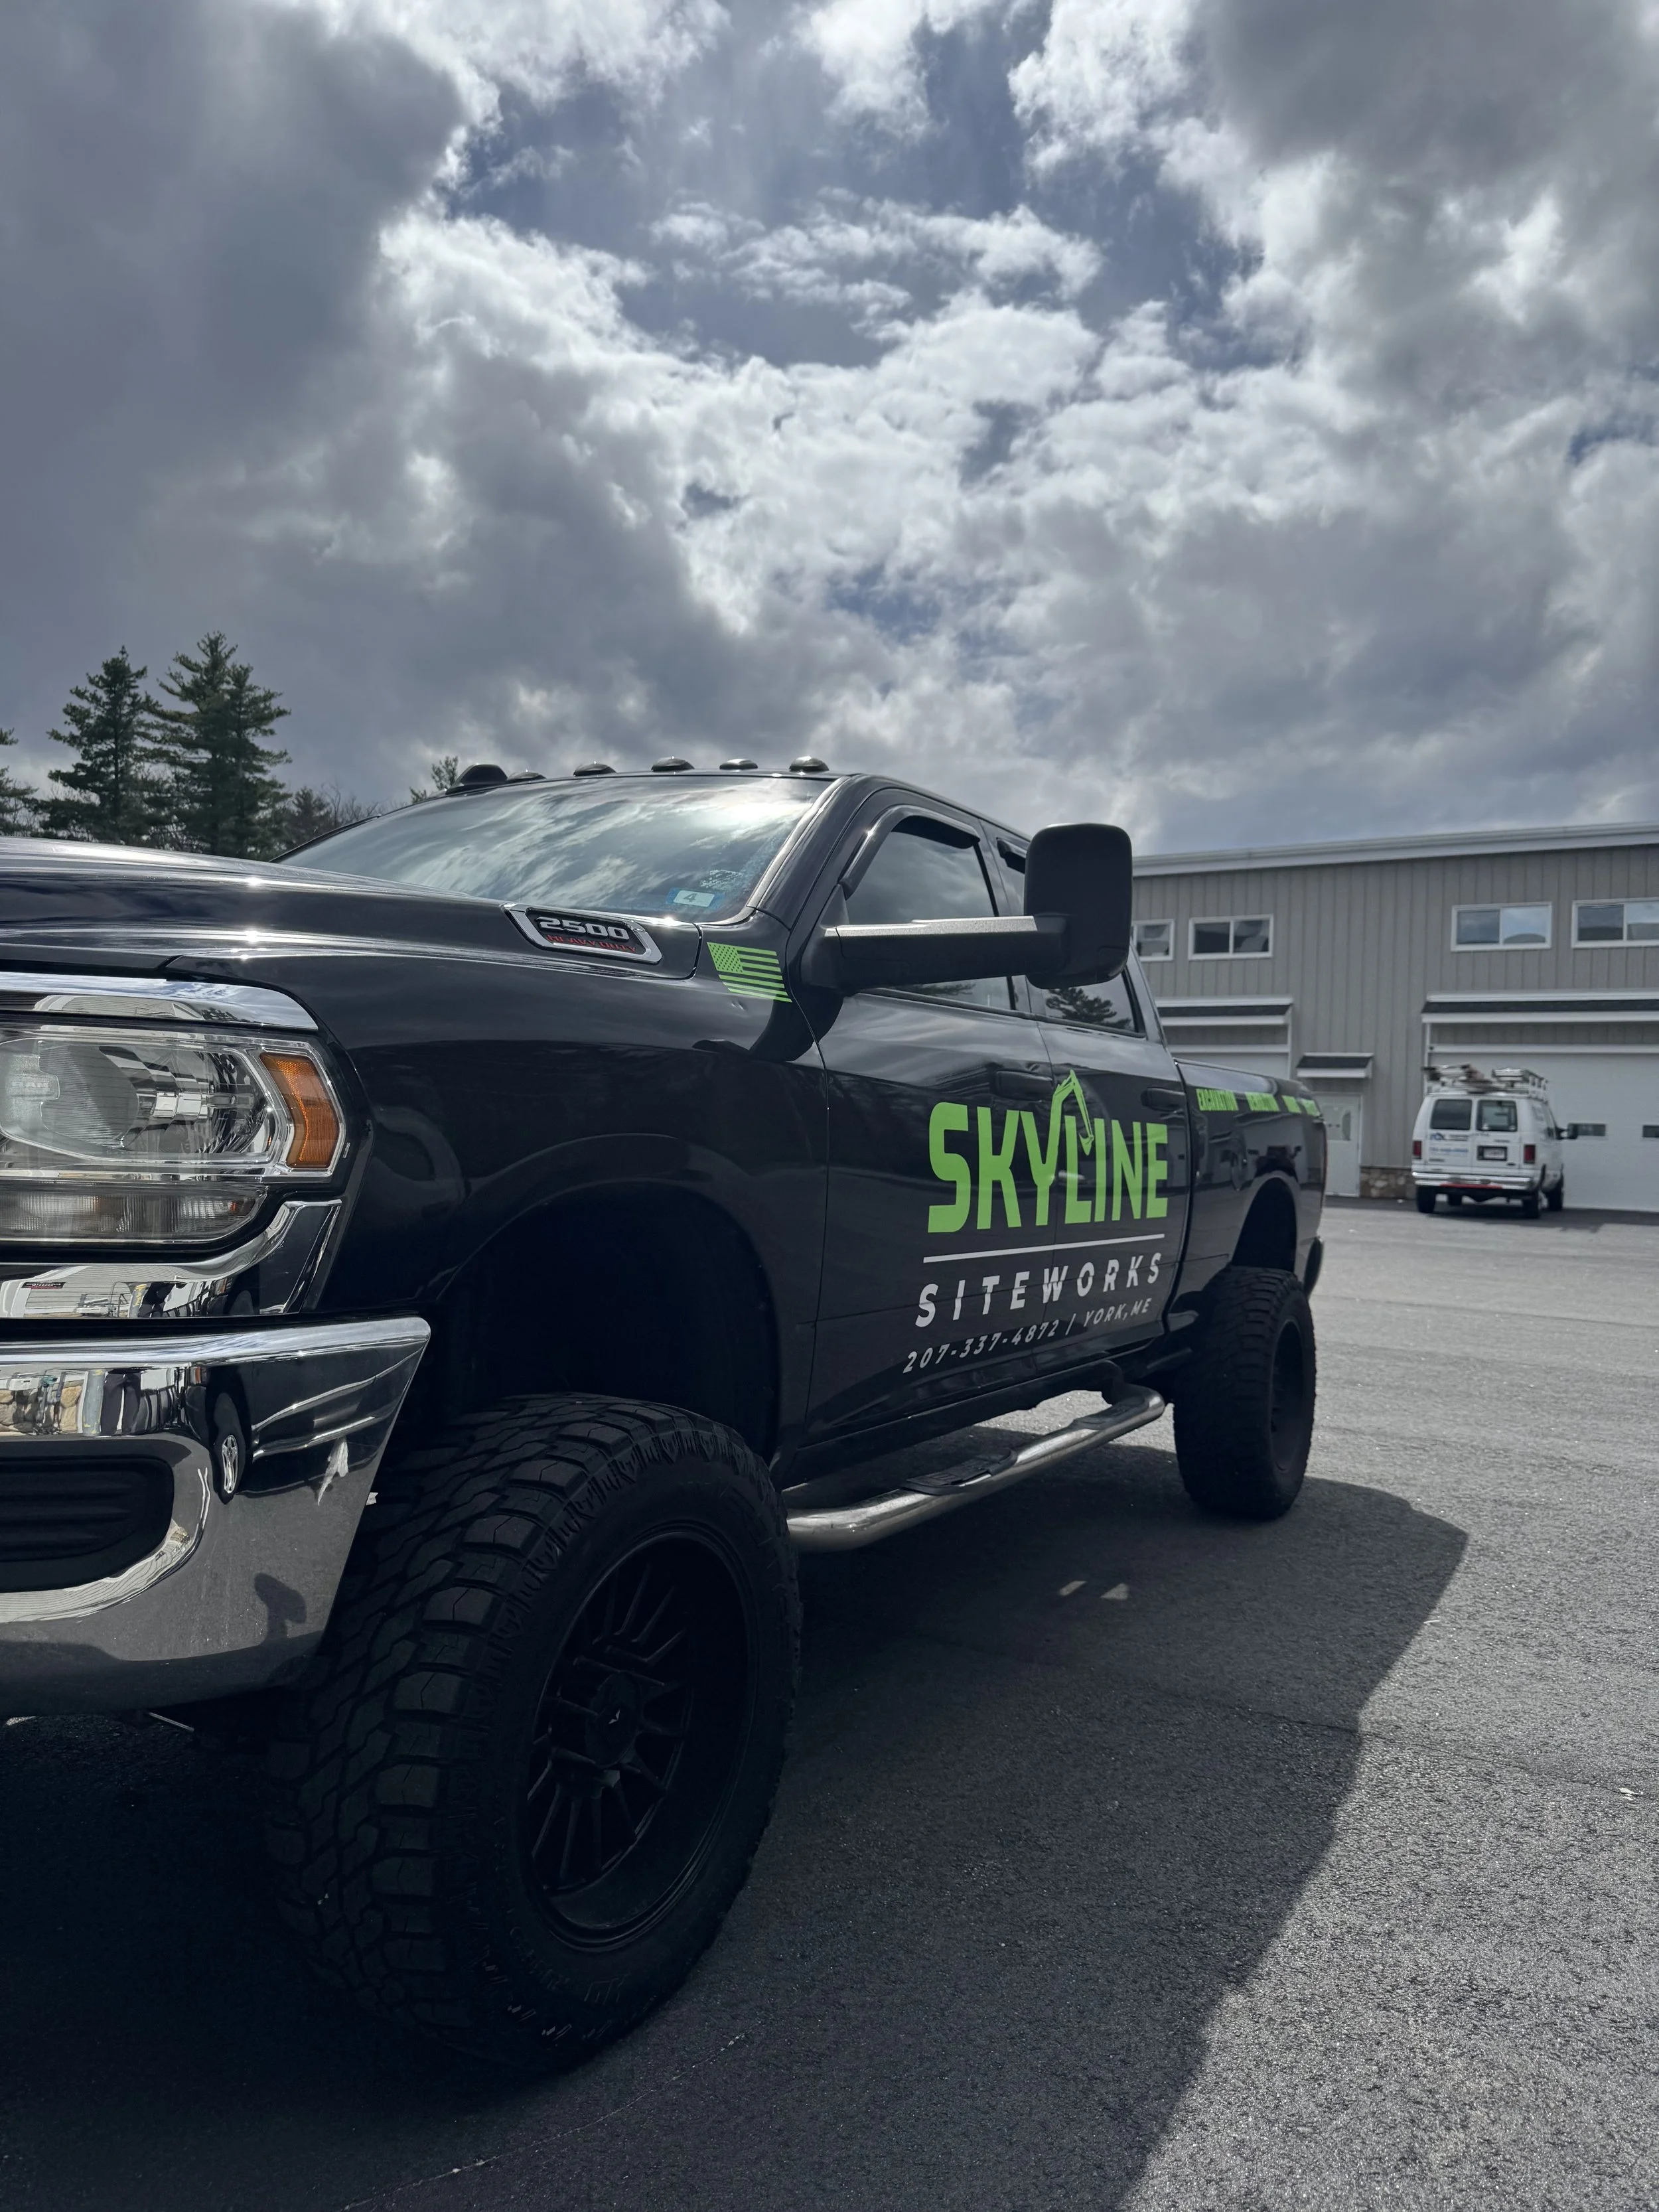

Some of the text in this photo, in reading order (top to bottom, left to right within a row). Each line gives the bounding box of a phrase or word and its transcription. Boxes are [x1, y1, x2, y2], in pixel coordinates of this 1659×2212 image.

[683, 893, 697, 902] 4
[536, 917, 630, 940] 2500
[928, 1069, 1168, 1233] SKYLINE
[915, 1253, 1162, 1327] SITEWORKS
[902, 1319, 1060, 1374] 207-337-4872
